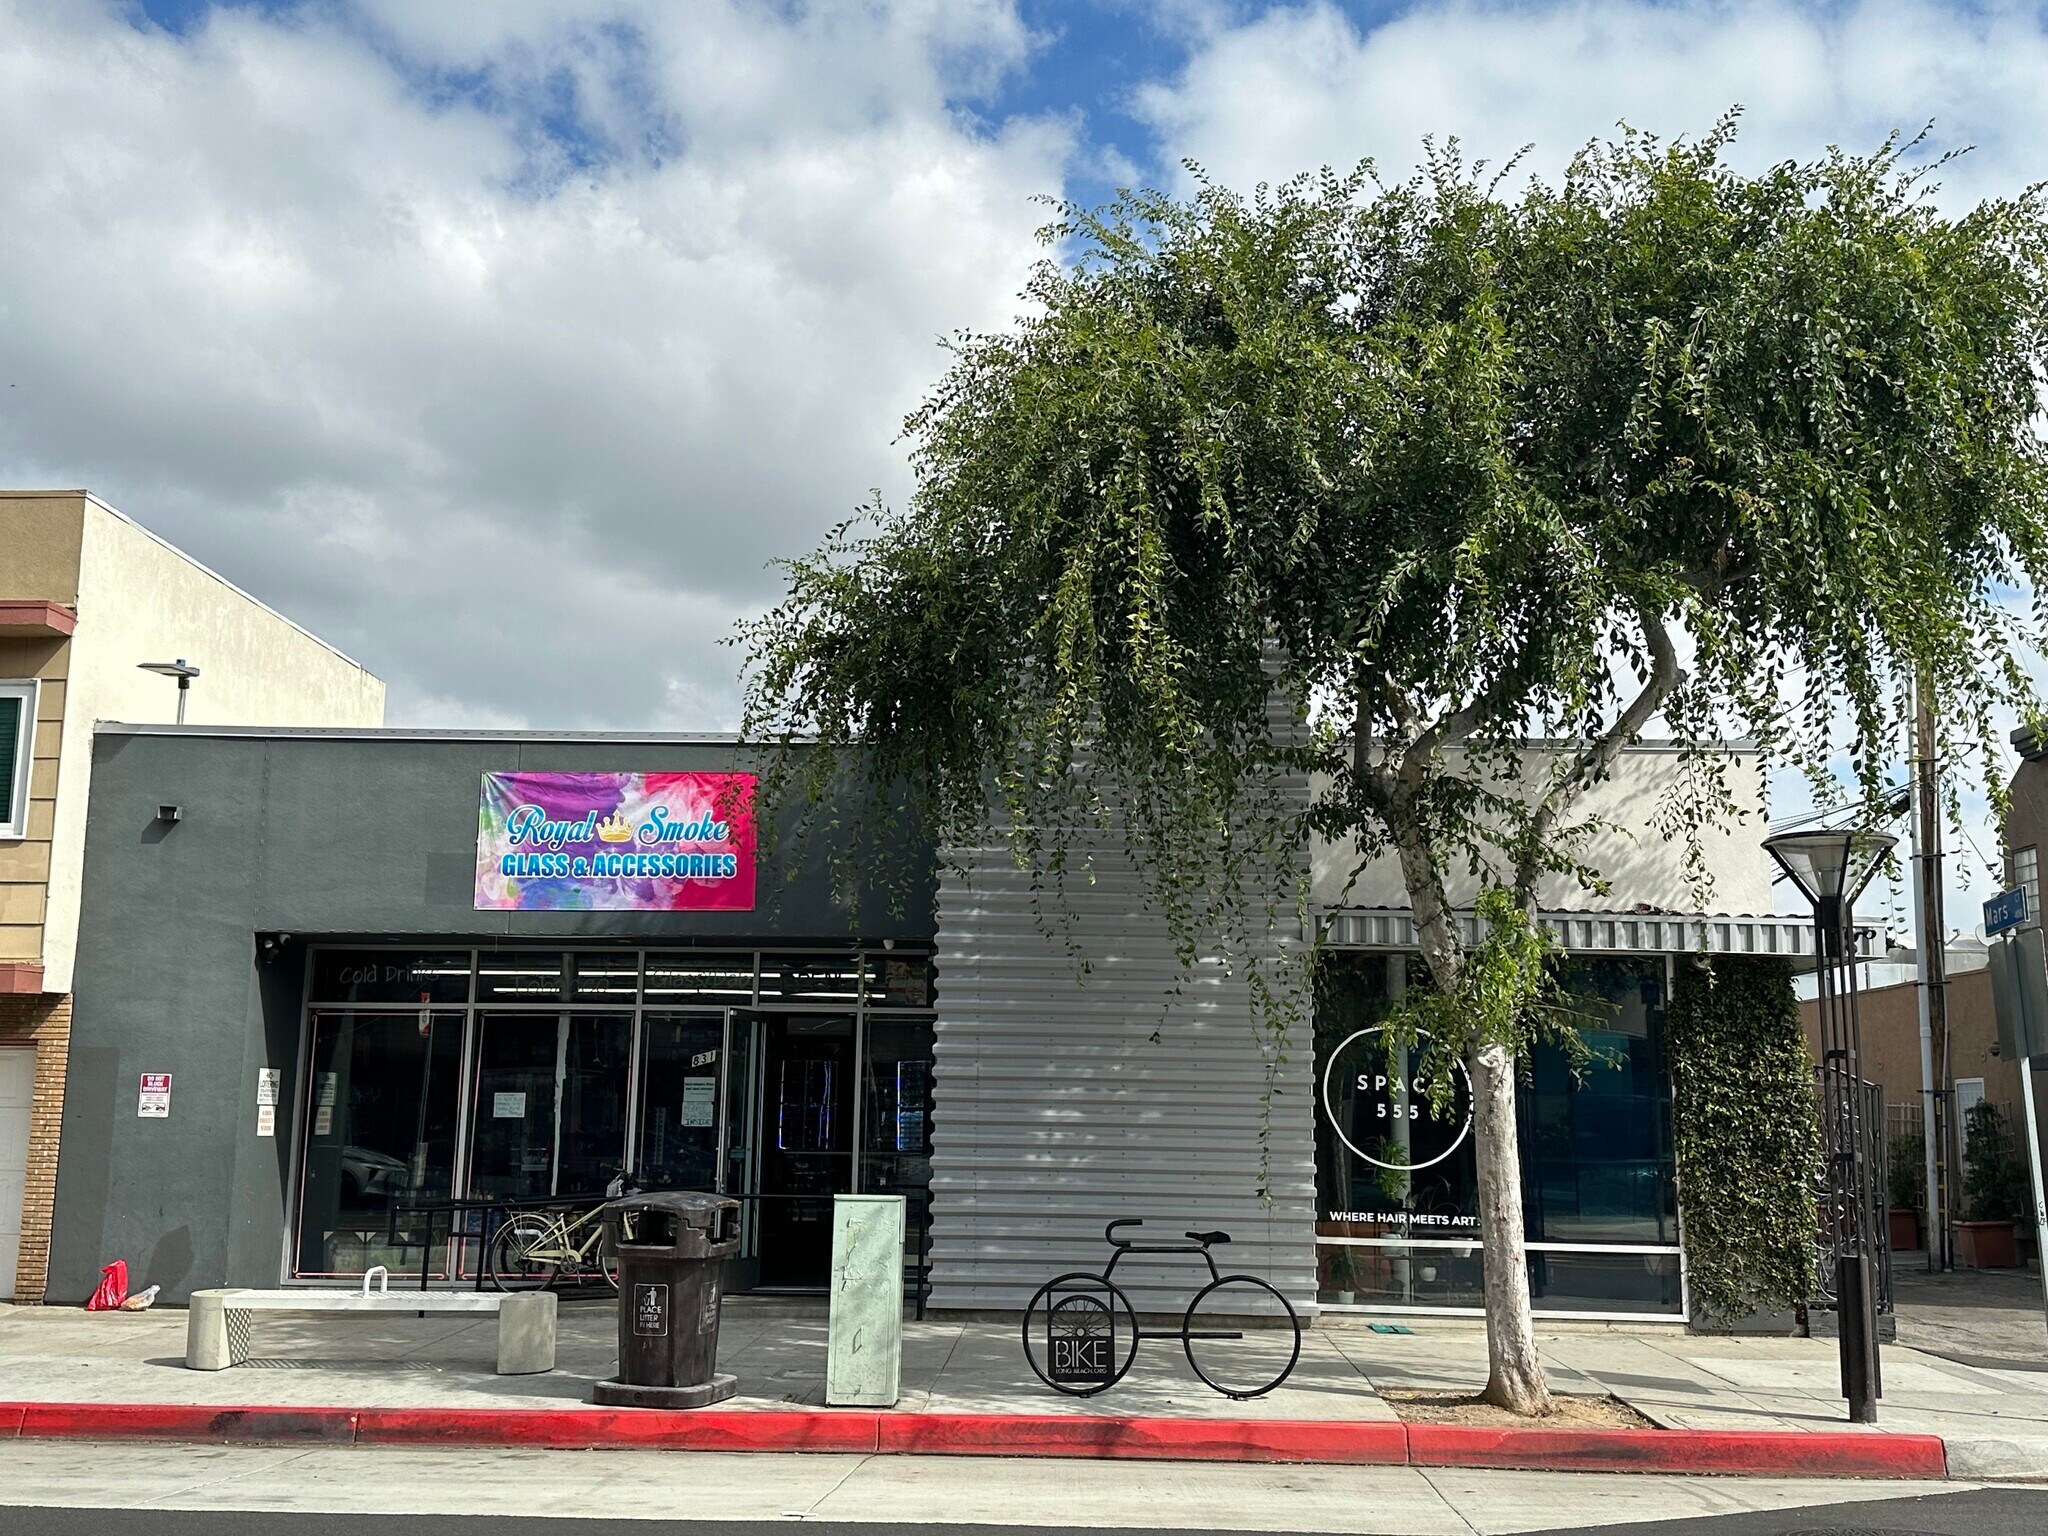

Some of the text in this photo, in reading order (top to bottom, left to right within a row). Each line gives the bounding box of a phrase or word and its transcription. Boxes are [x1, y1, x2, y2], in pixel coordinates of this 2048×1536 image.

[506, 805, 730, 849] Royal Smoke
[501, 853, 738, 879] GLASS & ACCESSORIES
[1985, 904, 2008, 927] Mars
[339, 963, 377, 984] Cold
[693, 1051, 714, 1067] 831
[1376, 1103, 1419, 1119] 555
[1329, 1211, 1375, 1222] WHERE
[1377, 1213, 1407, 1223] HAIR
[1409, 1214, 1449, 1225] MEETS
[640, 1305, 662, 1314] PLACE
[1055, 1340, 1107, 1368] BIKE
